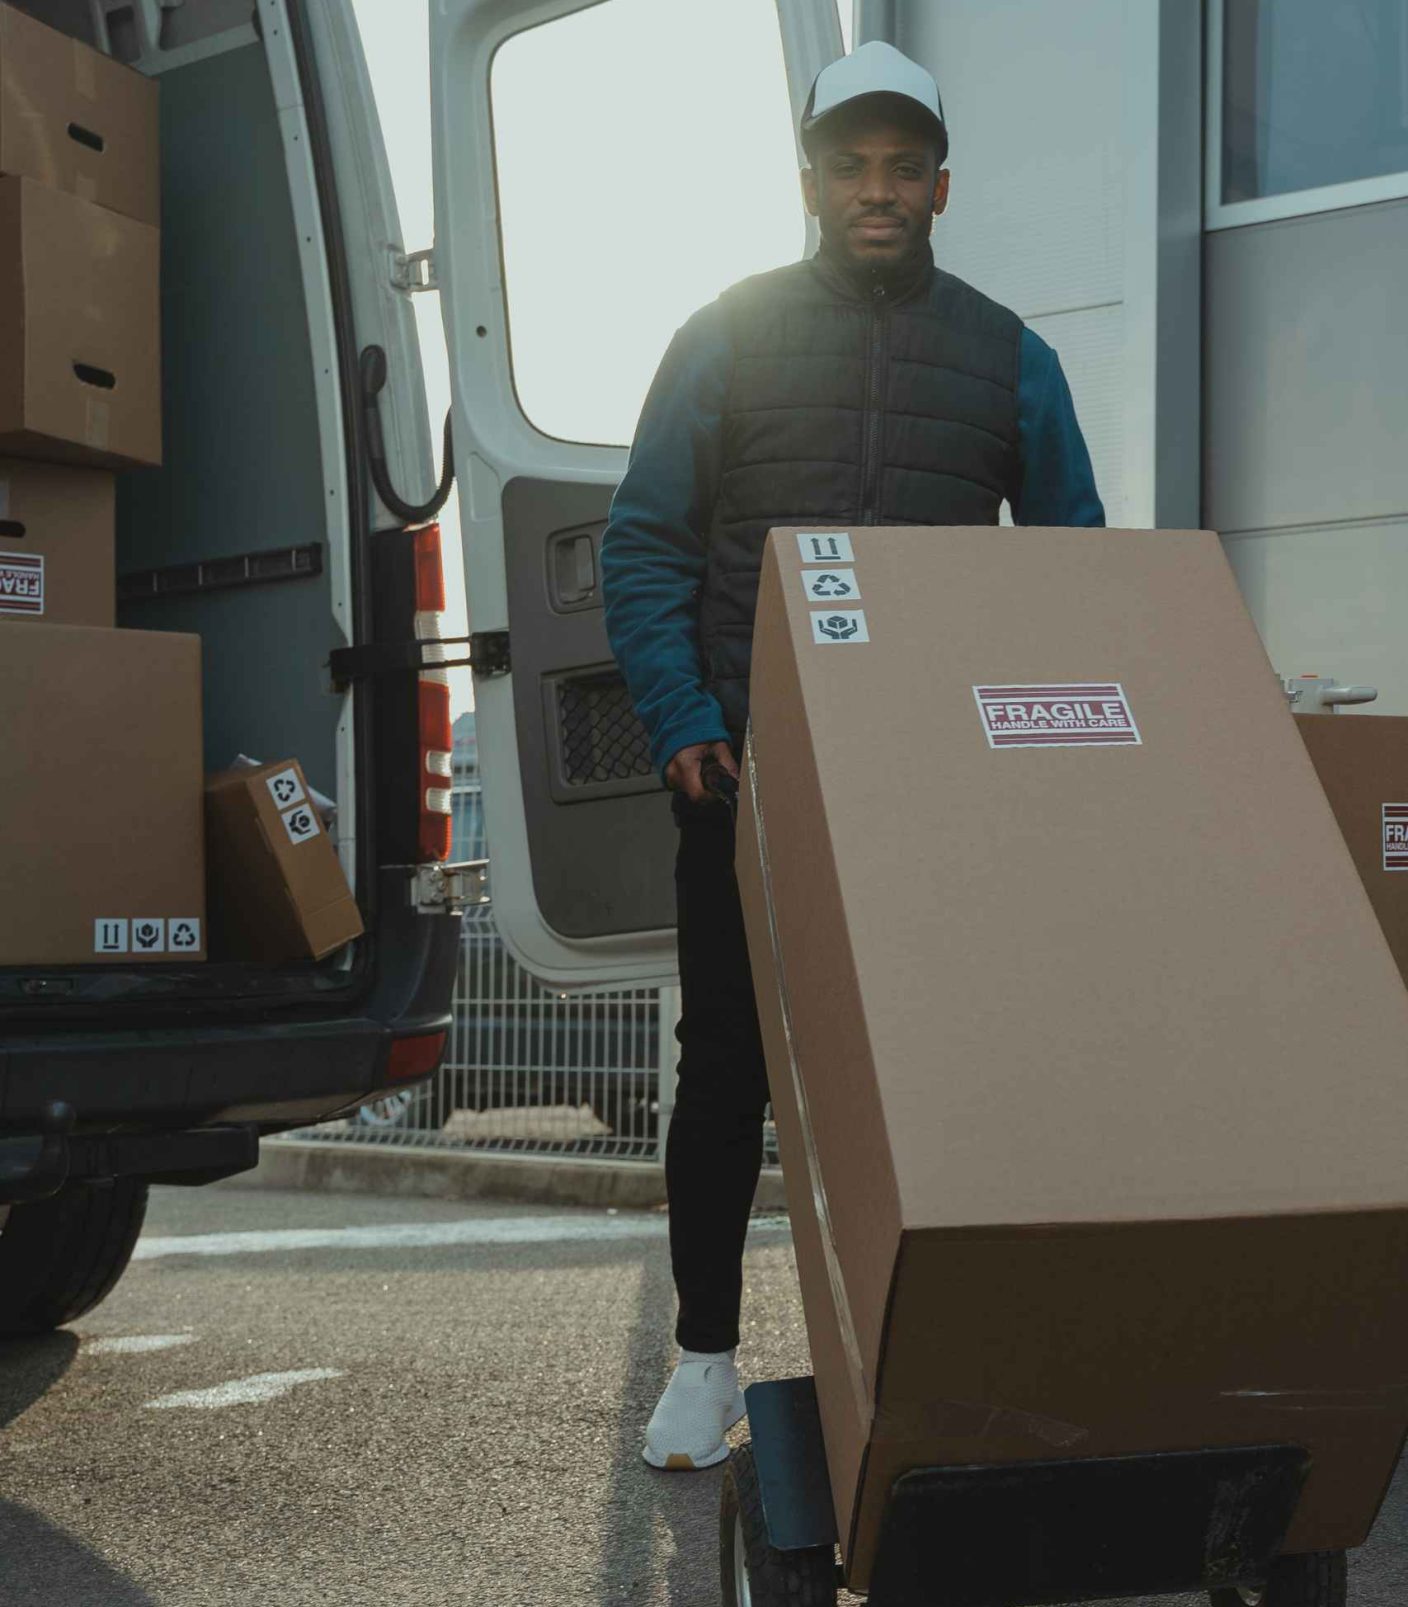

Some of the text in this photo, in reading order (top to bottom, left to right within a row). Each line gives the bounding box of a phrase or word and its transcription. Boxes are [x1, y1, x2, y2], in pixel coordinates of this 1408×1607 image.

[0, 577, 39, 596] FRA
[985, 703, 1125, 720] FRAGILE
[991, 718, 1128, 730] HANDLE WITH CARE
